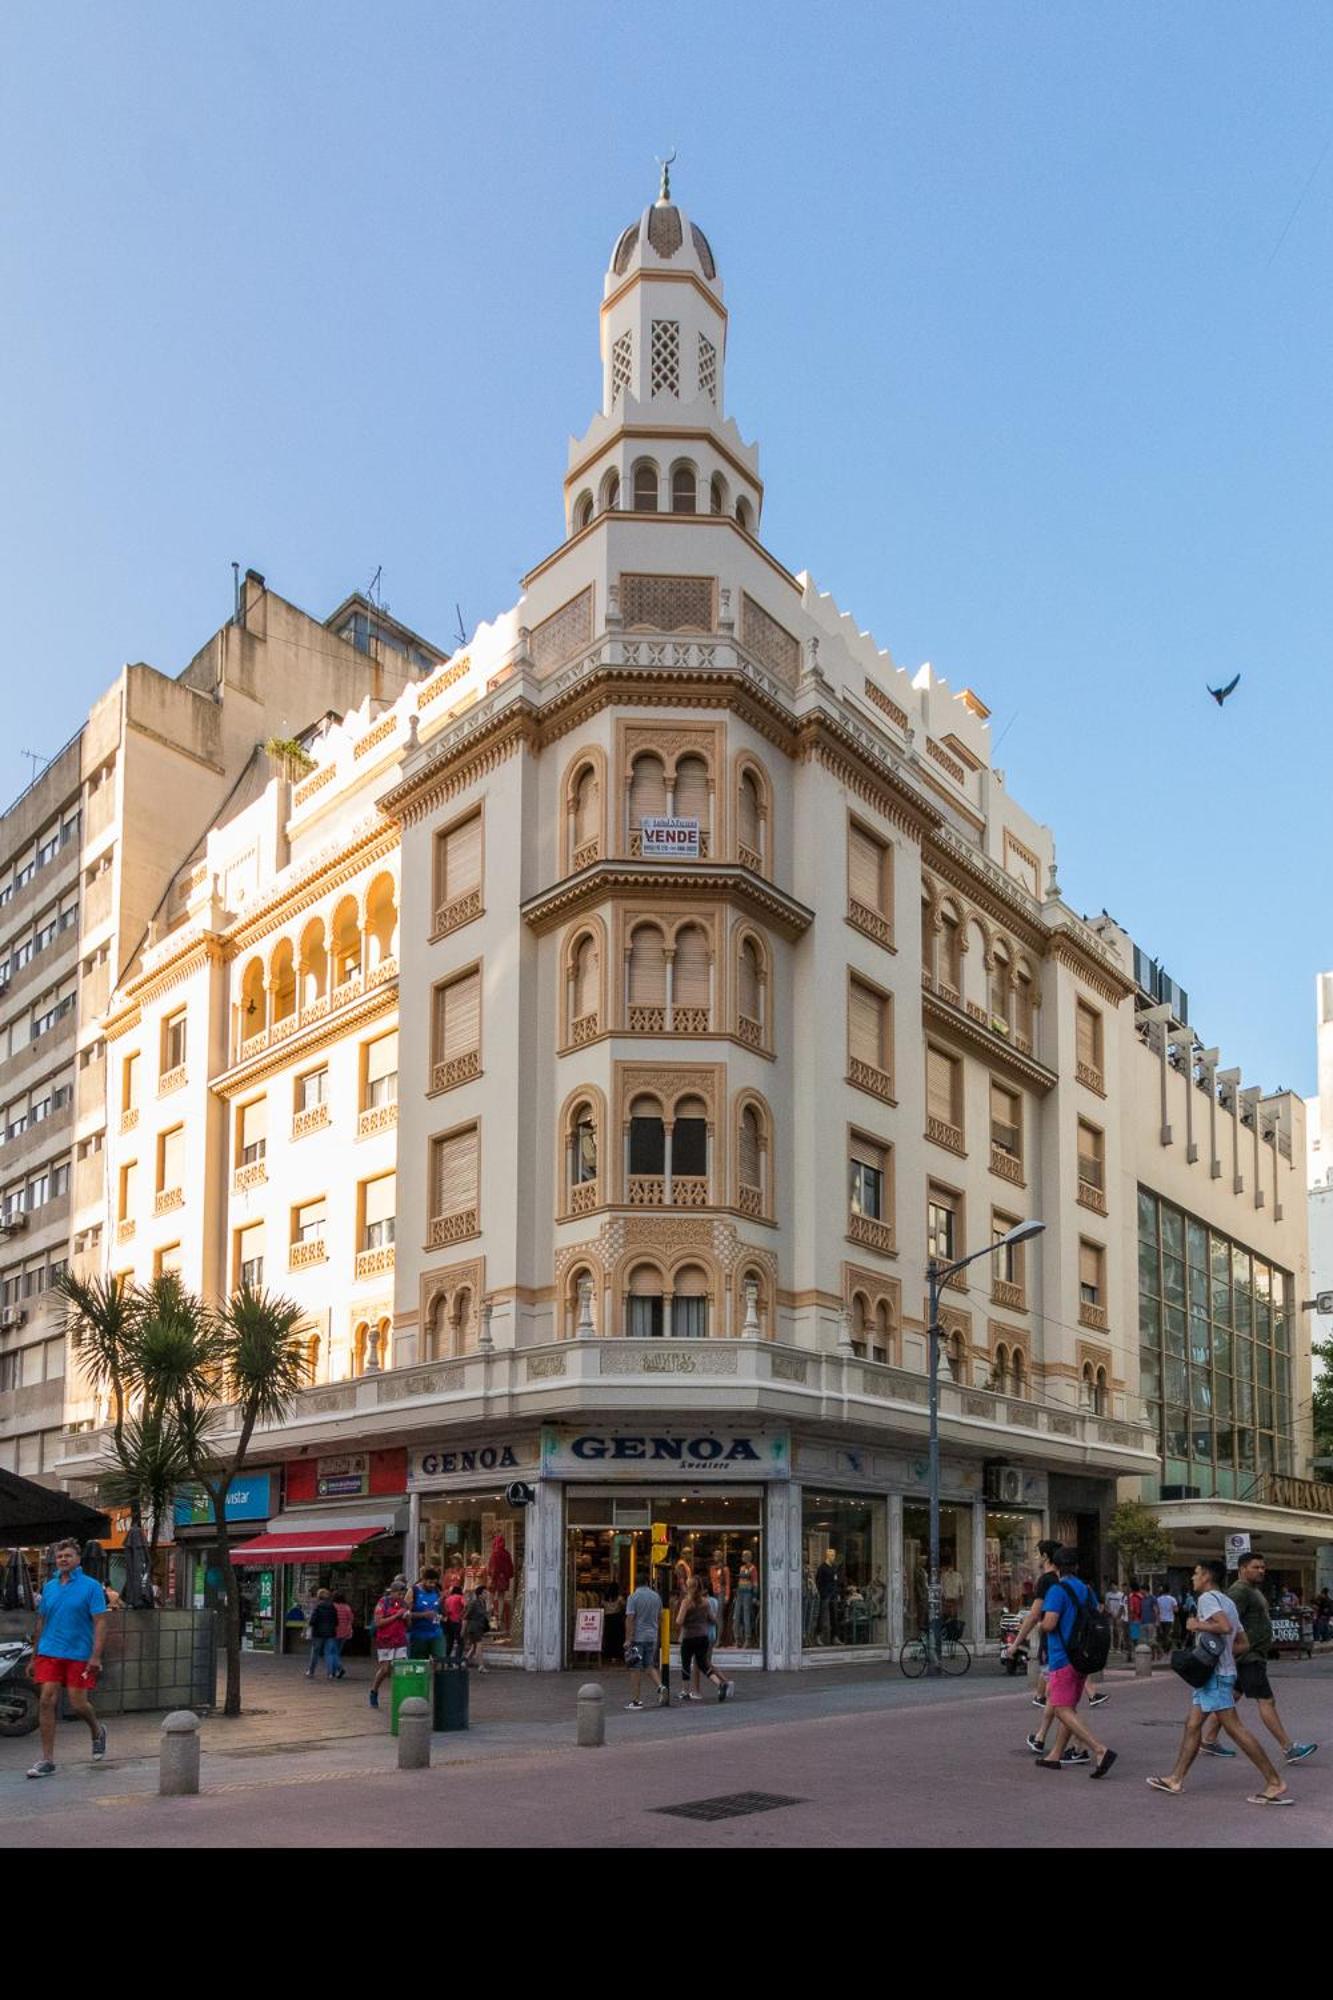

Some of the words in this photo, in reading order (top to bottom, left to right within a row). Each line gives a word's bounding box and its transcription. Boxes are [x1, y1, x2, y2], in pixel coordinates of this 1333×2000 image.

[644, 829, 697, 843] VENDE
[422, 1446, 519, 1475] GENOA
[571, 1436, 761, 1461] GENOA
